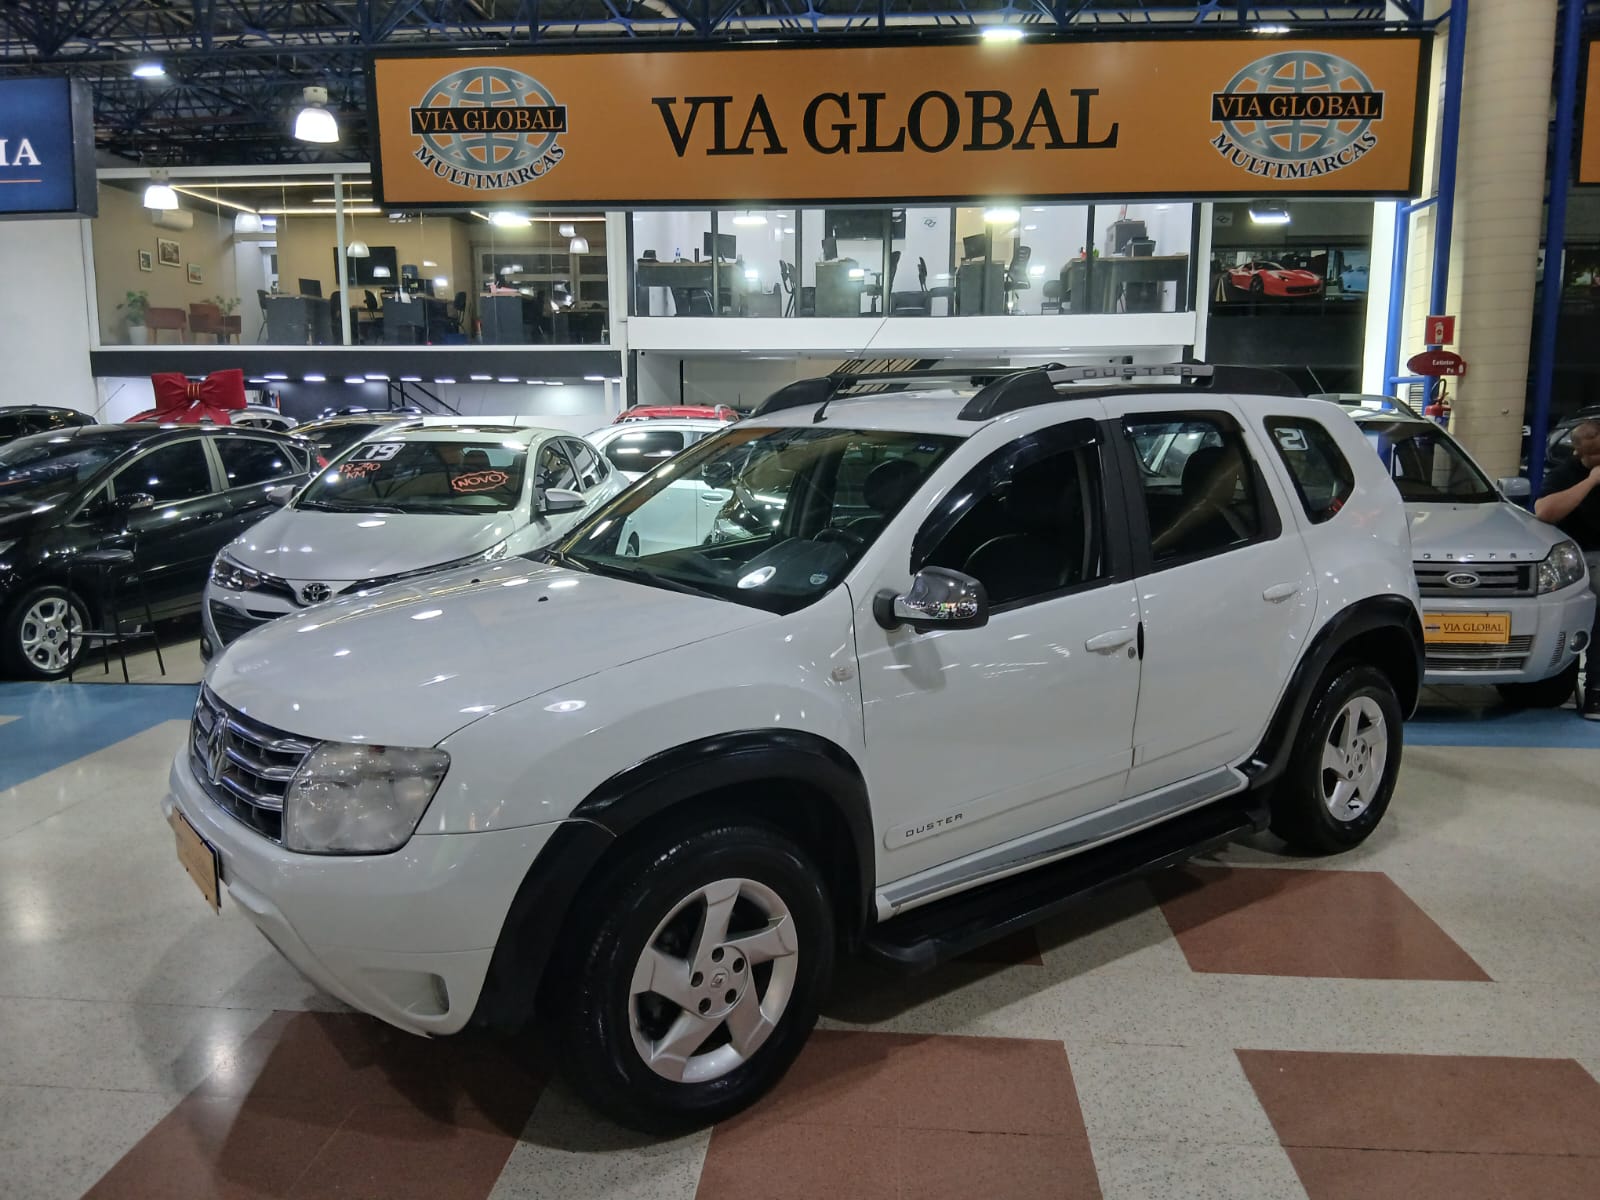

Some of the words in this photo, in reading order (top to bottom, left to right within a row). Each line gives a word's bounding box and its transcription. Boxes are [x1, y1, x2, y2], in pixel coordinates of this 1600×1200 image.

[1216, 96, 1264, 118] VIA
[1269, 95, 1379, 118] GLOBAL
[415, 111, 459, 131] VIA
[463, 109, 564, 131] GLOBAL
[652, 93, 788, 158] VIA
[803, 88, 1119, 155] GLOBAL
[1212, 131, 1377, 179] MULTIMARCAS
[415, 144, 565, 189] MULTIMARCAS
[1082, 366, 1193, 378] DUSTER
[345, 471, 366, 480] KM
[457, 473, 502, 488] NOVO
[1443, 623, 1460, 632] VIA
[1463, 623, 1504, 632] GLOBAL
[905, 813, 963, 838] DUSTER
